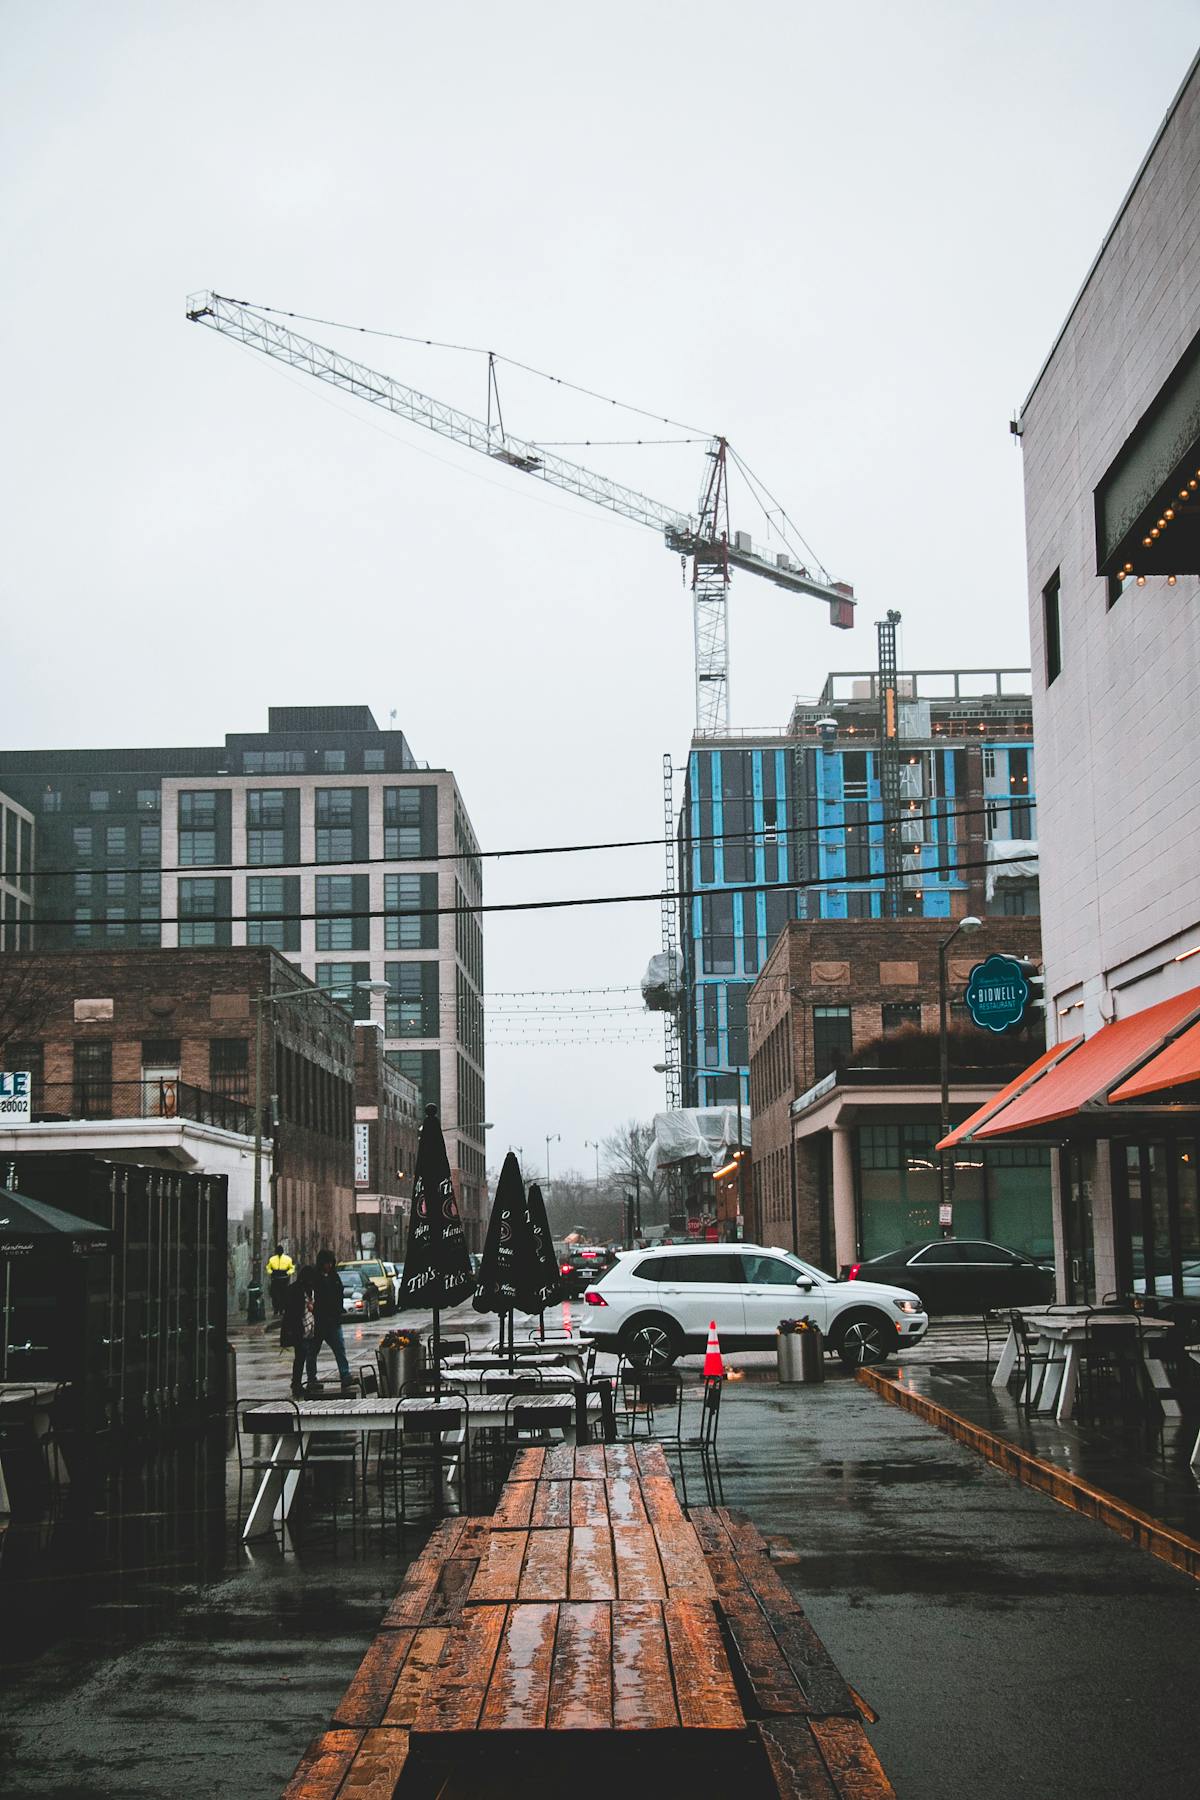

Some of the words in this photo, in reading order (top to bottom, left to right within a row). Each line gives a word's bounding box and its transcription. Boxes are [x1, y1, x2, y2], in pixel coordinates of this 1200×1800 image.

[978, 986, 1015, 1002] BIDWELL
[978, 1000, 1016, 1010] RESTAURANT
[0, 1073, 27, 1096] LE
[1, 1100, 28, 1112] 20002
